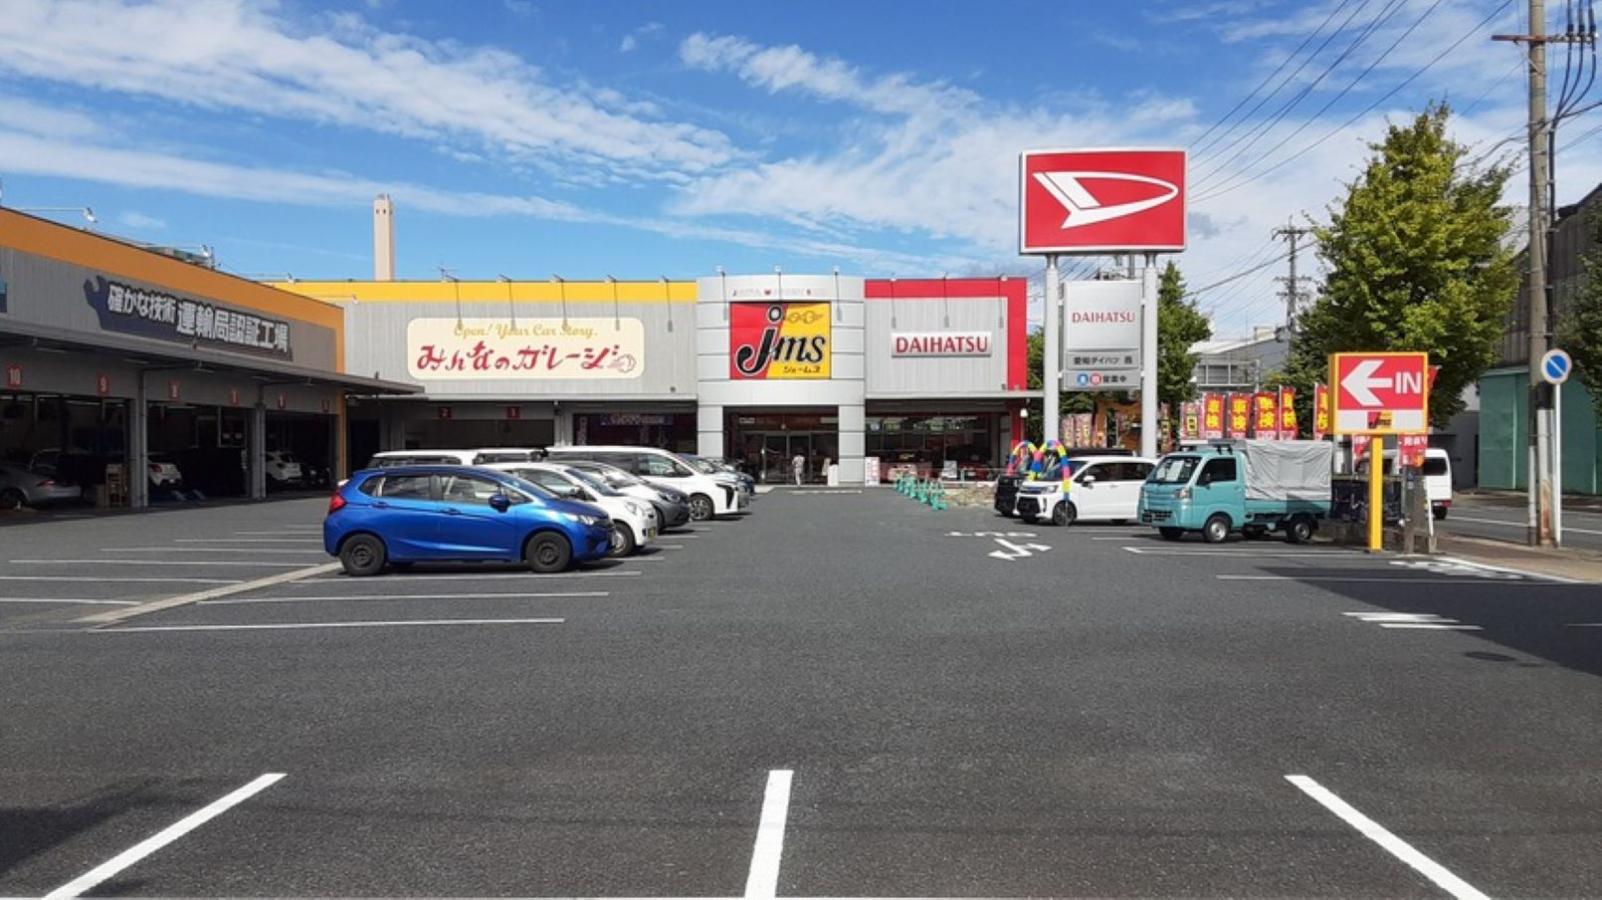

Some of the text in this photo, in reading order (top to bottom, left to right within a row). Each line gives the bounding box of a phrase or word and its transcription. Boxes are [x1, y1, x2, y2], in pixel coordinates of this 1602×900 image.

[107, 285, 289, 352] 確かな技術 運輸局認証工場
[1072, 312, 1135, 323] DAIHATSU
[736, 304, 826, 376] jms
[895, 336, 988, 353] DAIHATSU
[417, 340, 620, 371] みんなのガレージ
[1394, 371, 1422, 394] IN
